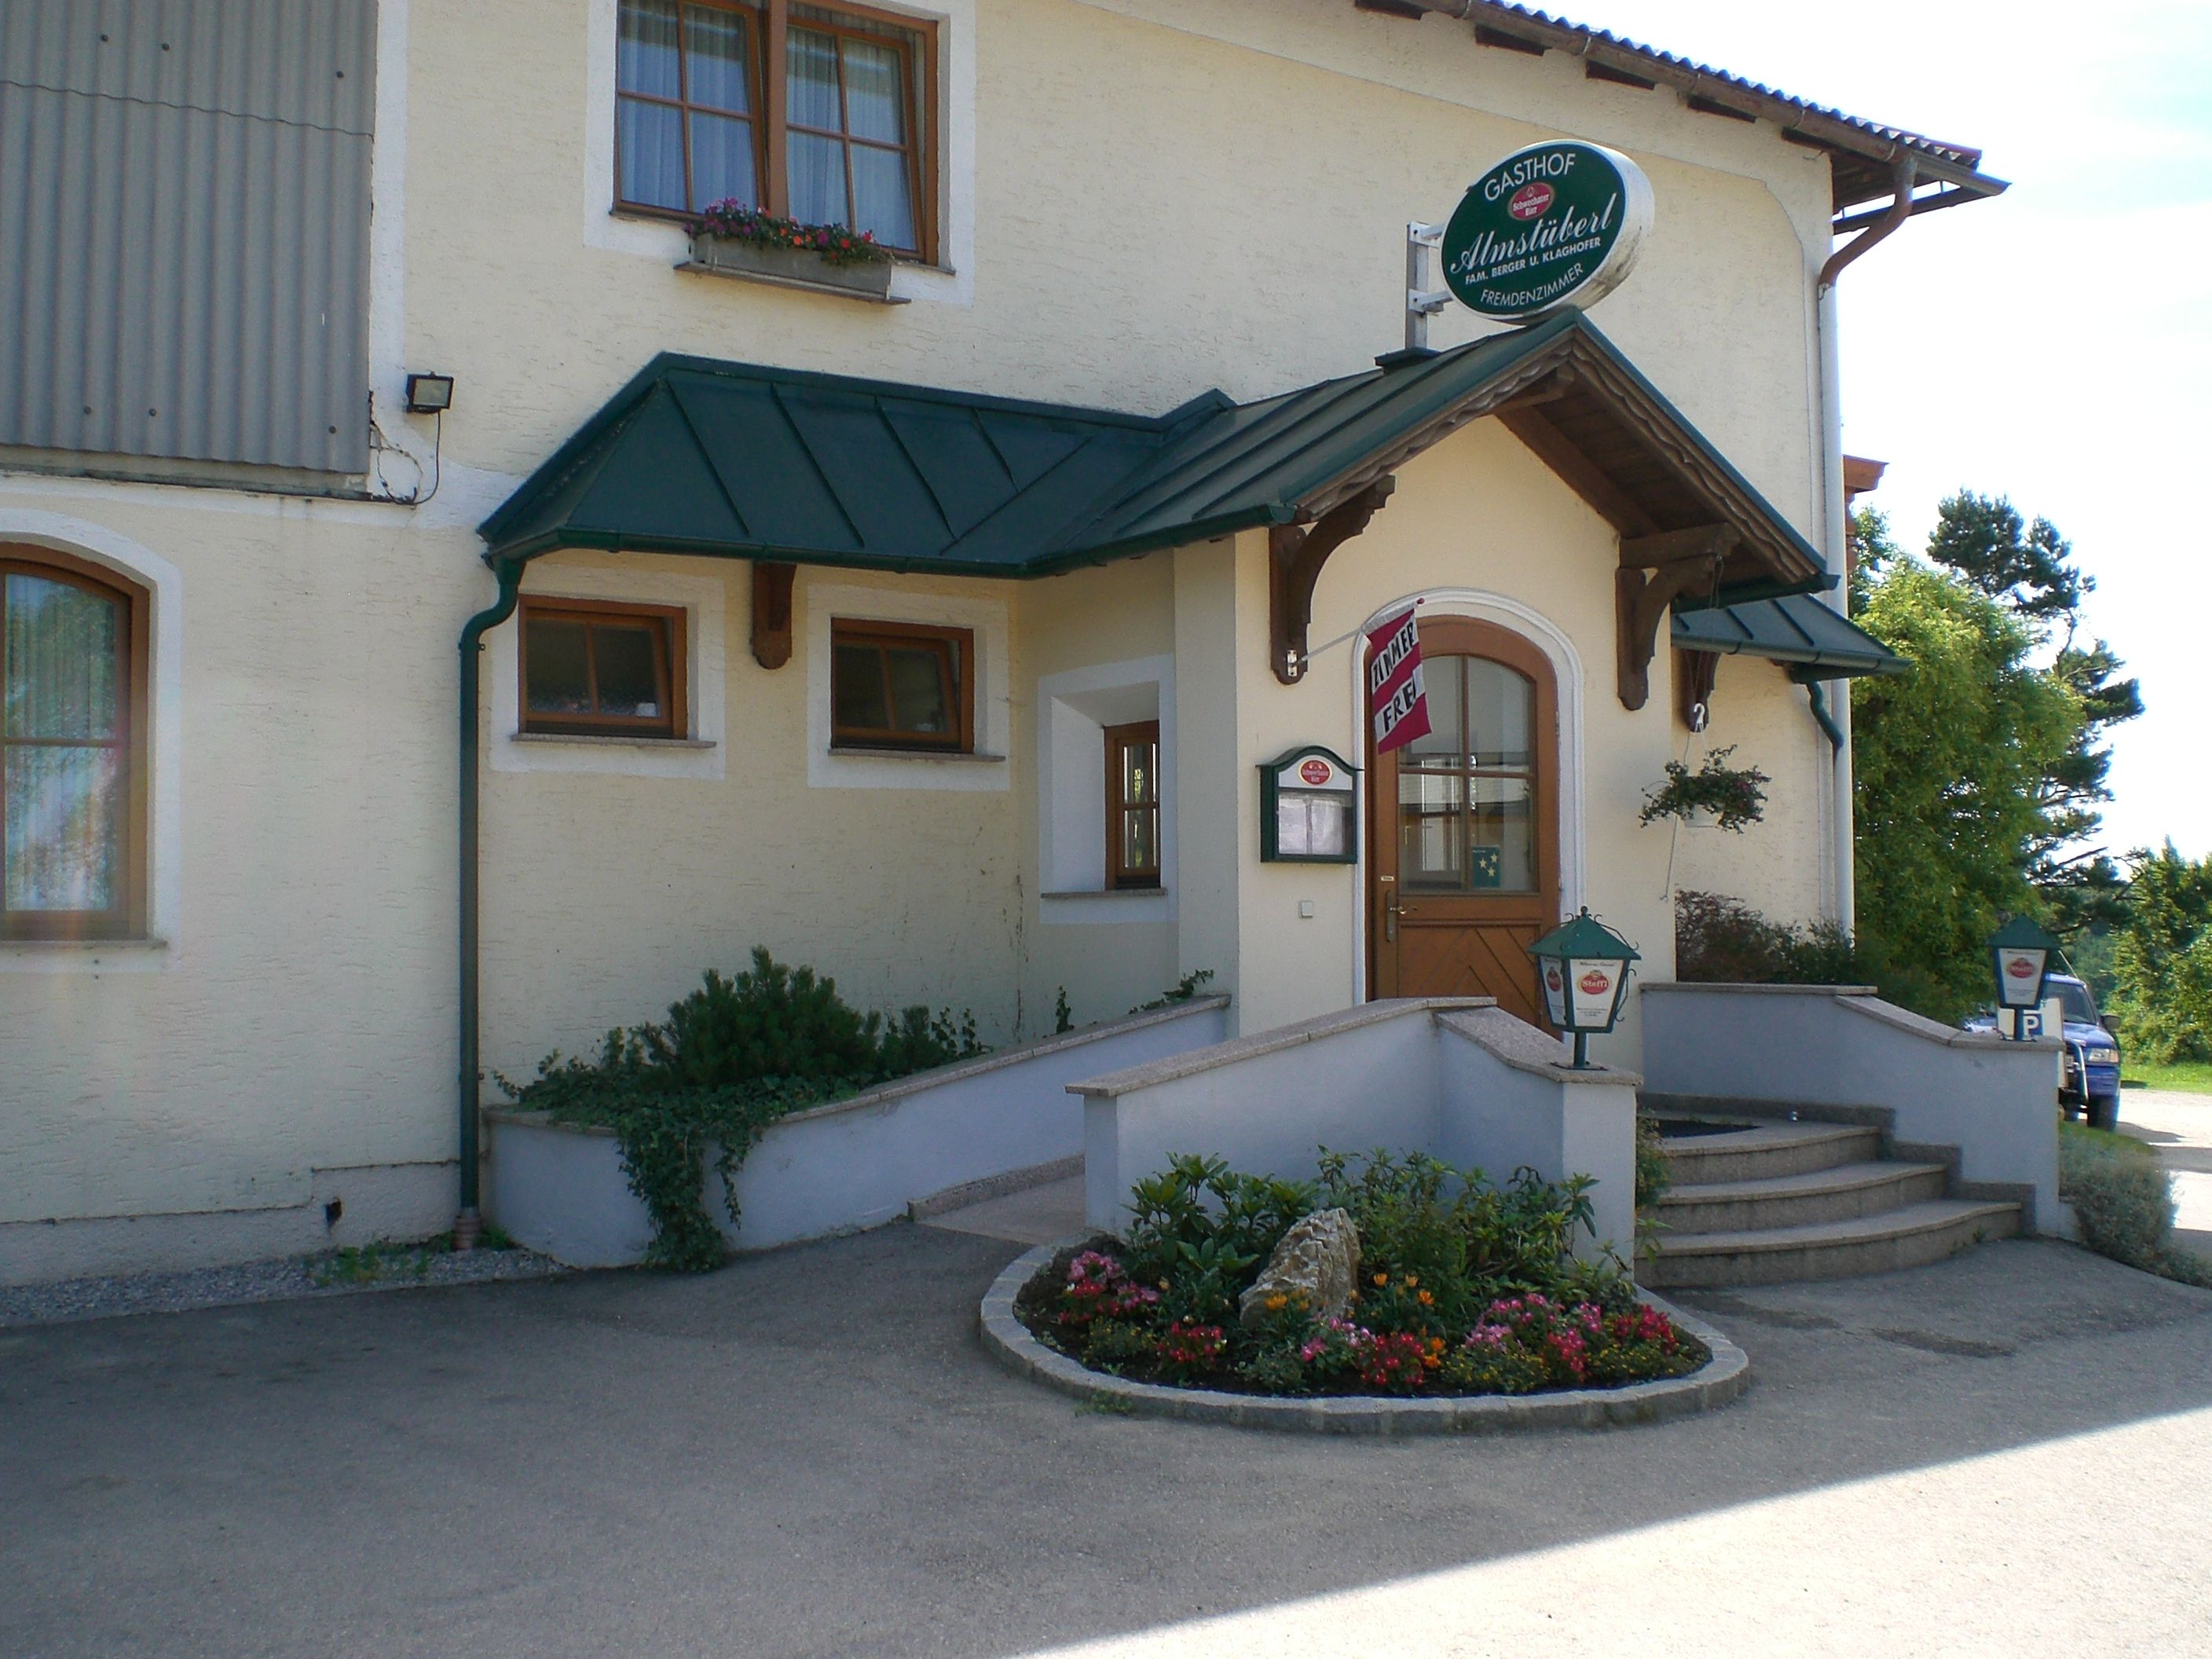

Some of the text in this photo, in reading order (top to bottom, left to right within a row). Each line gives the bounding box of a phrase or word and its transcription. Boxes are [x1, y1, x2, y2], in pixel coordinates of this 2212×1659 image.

[1485, 153, 1576, 201] GASTHOF
[1450, 192, 1617, 273] Almstüberl
[1465, 237, 1601, 285] FAM. BERGER U. KLAGHOFER
[1481, 262, 1584, 307] FREMDENZIMMER
[1373, 621, 1414, 689] ZIMMER
[1383, 676, 1416, 731] FREI
[2023, 1016, 2039, 1037] P
